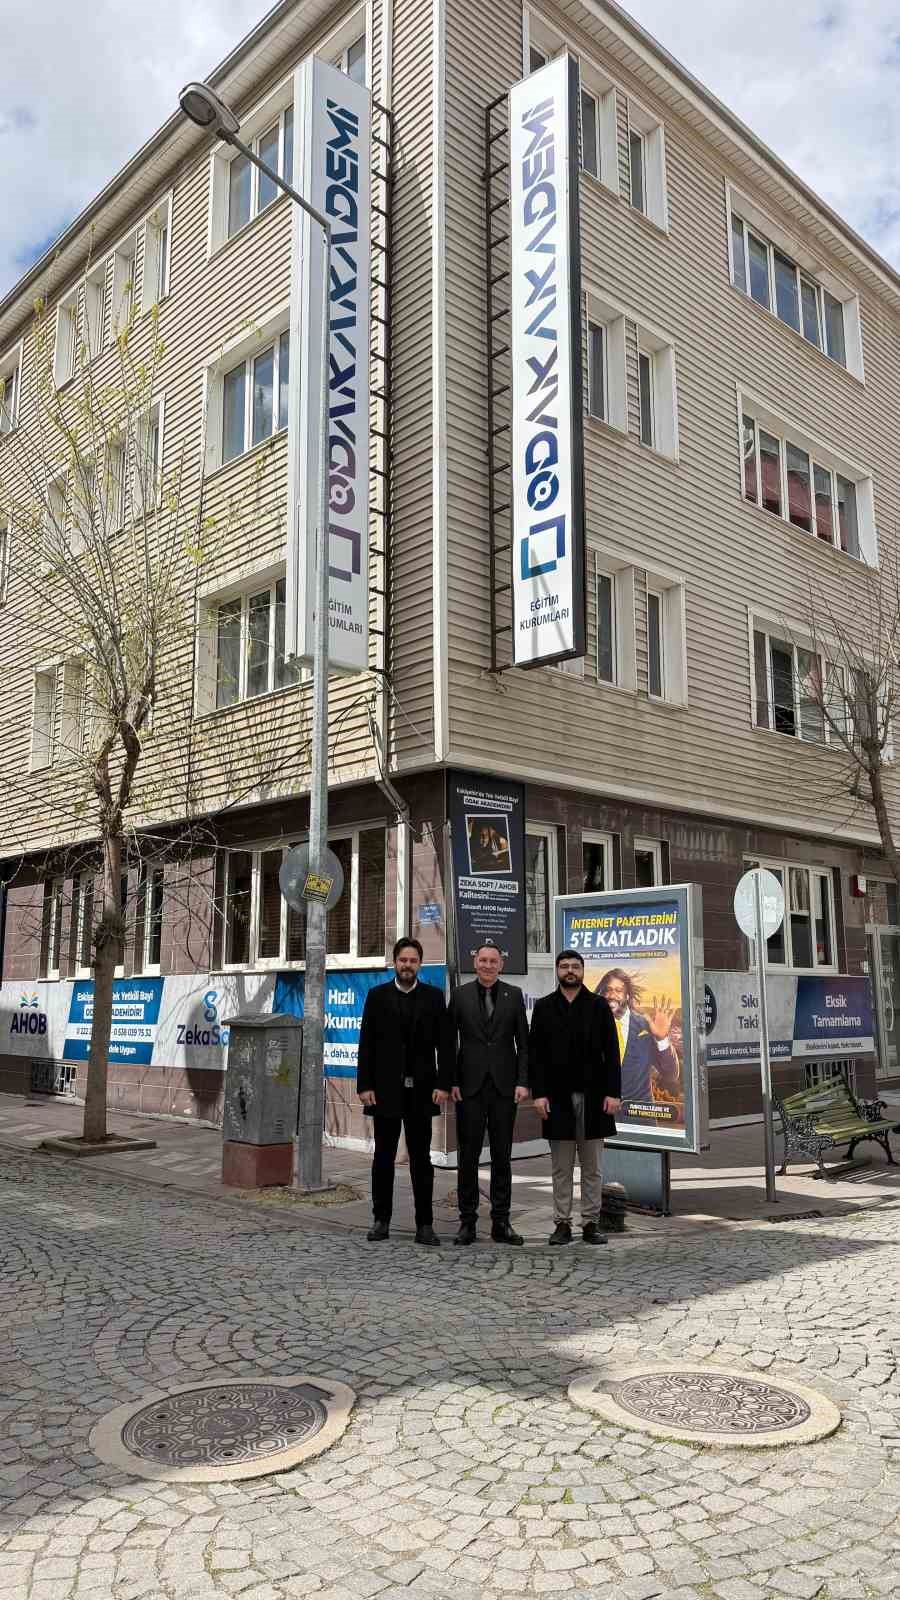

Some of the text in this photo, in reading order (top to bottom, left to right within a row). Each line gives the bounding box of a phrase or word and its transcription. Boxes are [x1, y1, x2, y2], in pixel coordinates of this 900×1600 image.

[328, 598, 352, 616] ĞİTİM
[530, 593, 560, 612] EĞİTİM
[520, 608, 570, 631] KURUMLARI
[459, 879, 477, 887] ZEKA
[459, 890, 489, 899] Kalitesini
[570, 911, 677, 929] İNTERNET PAKETLERİNİ
[570, 927, 677, 948] 5'E KATLADIK
[121, 991, 139, 1001] Yetkili
[140, 990, 154, 1003] Bayi
[328, 988, 355, 1005] Hızlı
[825, 994, 848, 1008] Eksik
[10, 1012, 47, 1035] AHOB
[737, 1014, 760, 1029] Taki
[811, 1014, 862, 1029] Tamamlama
[176, 1025, 230, 1046] ZekaSo
[330, 1048, 349, 1058] daha
